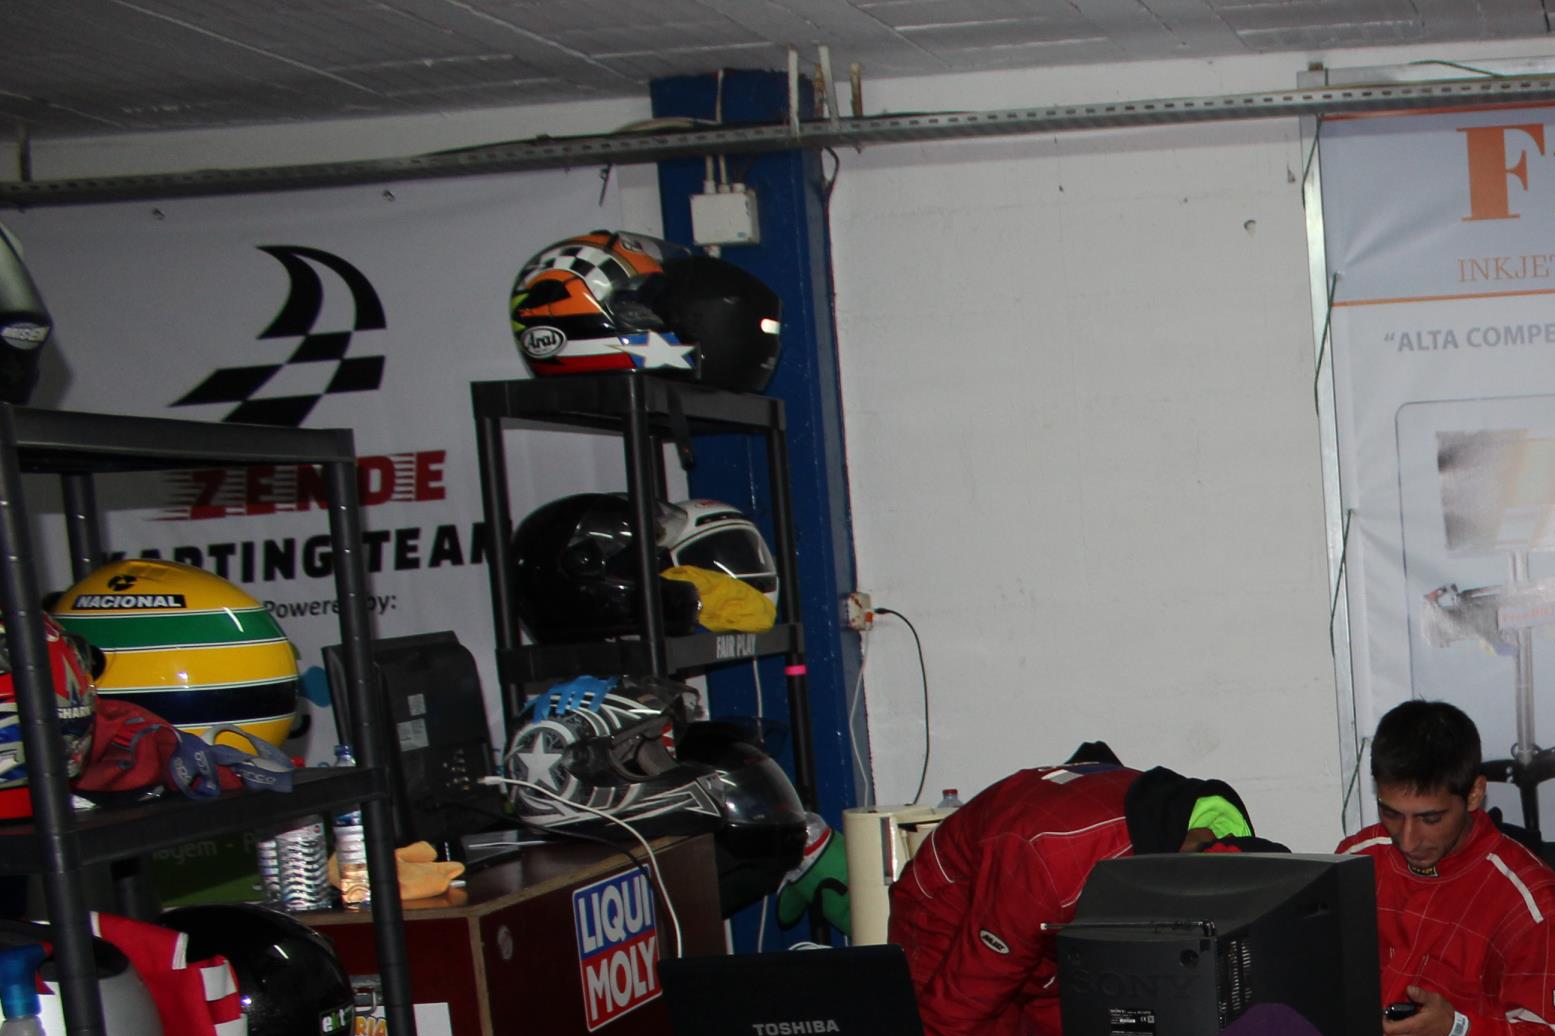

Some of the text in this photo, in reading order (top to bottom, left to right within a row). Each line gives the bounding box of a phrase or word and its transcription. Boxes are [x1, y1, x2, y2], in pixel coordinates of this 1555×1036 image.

[525, 330, 558, 351] Arai
[186, 450, 446, 520] ZENDE
[102, 533, 335, 584] TING
[75, 595, 182, 609] NACIONAL
[264, 597, 339, 620] Powere
[716, 635, 736, 659] FAIR
[577, 872, 651, 954] LIQUI
[586, 936, 657, 1022] MOLY
[752, 1019, 841, 1036] TOSHIBA
